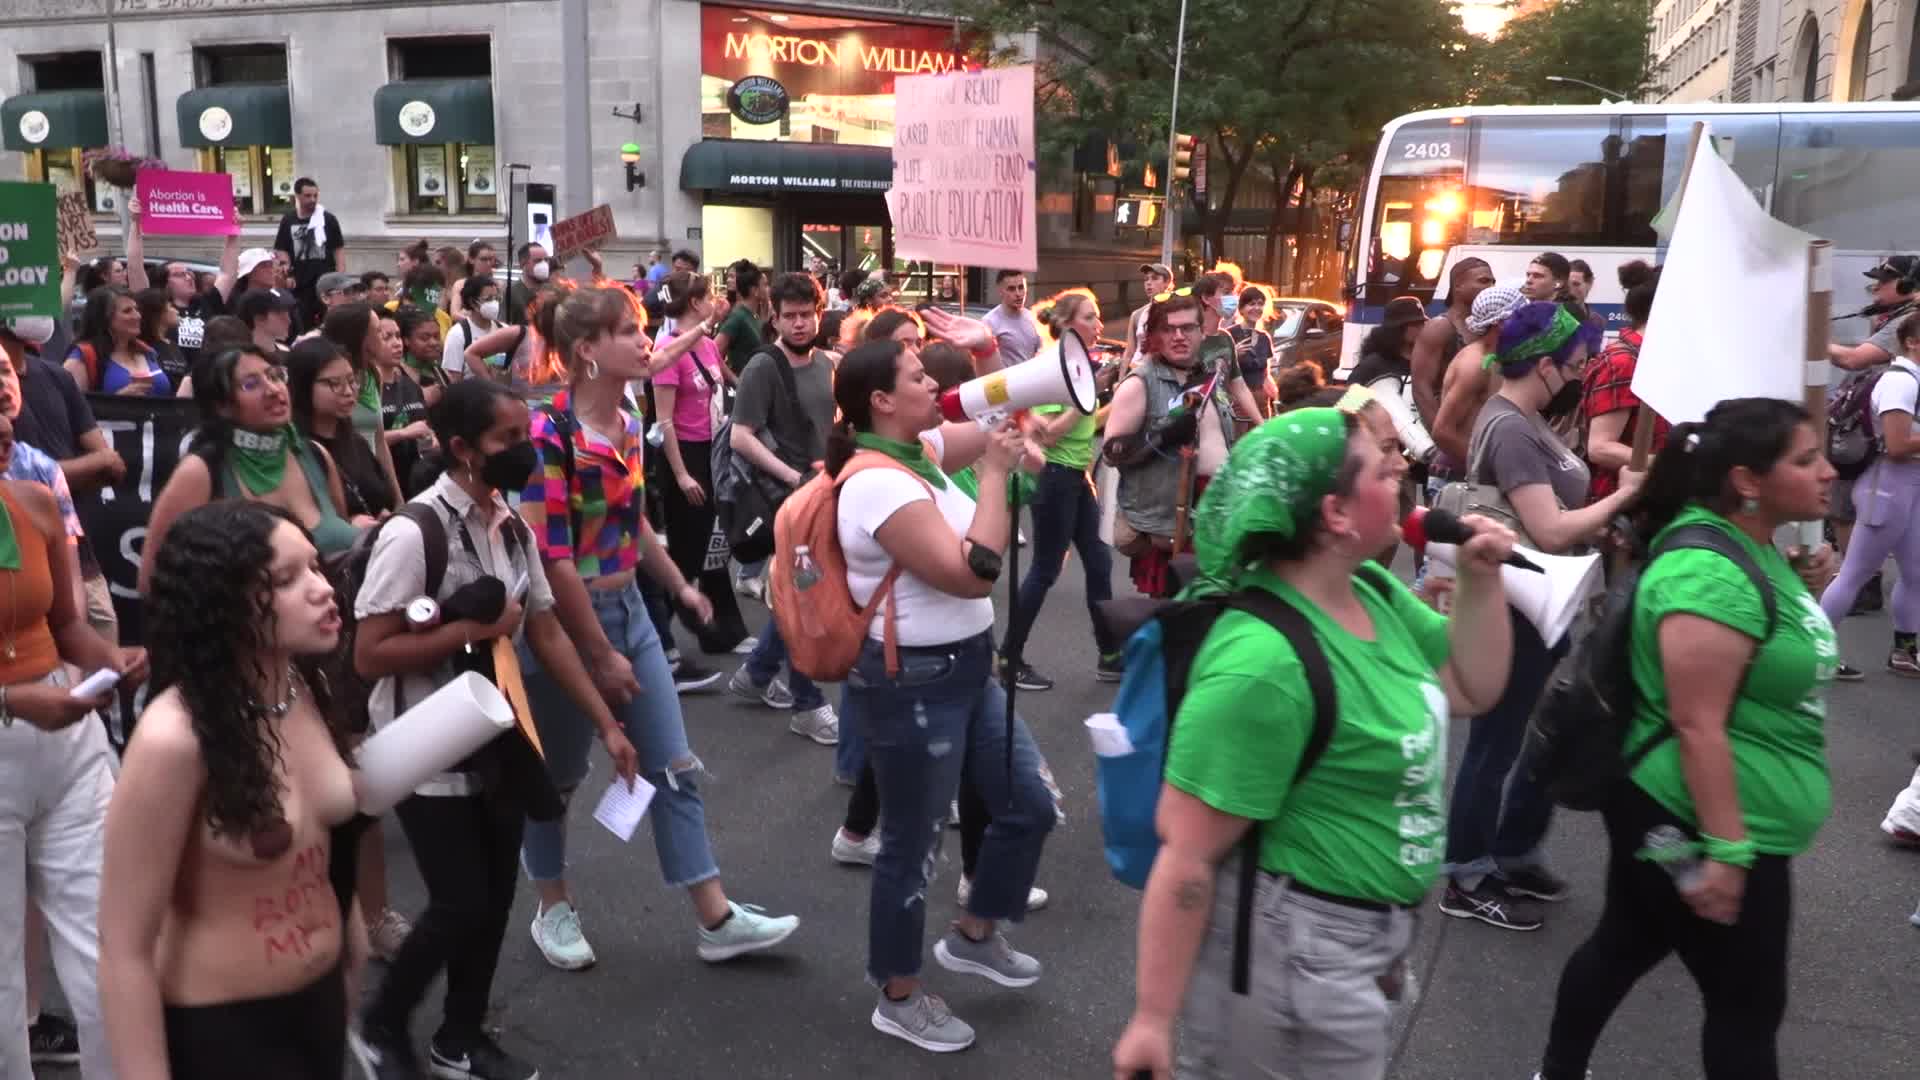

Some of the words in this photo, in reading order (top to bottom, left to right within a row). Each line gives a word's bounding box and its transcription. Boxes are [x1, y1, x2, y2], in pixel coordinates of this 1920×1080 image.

[725, 32, 840, 66] MORTON
[975, 115, 1019, 149] HUMAN
[1404, 143, 1451, 159] 2403
[994, 153, 1025, 184] FUND
[730, 175, 778, 185] MORTON
[783, 177, 837, 188] WILLIAMS
[149, 187, 195, 201] Abortion
[197, 190, 206, 202] is
[149, 201, 190, 214] Health
[191, 203, 223, 215] Care.
[900, 188, 942, 235] PUBLIC
[947, 188, 1024, 243] EDUCATION
